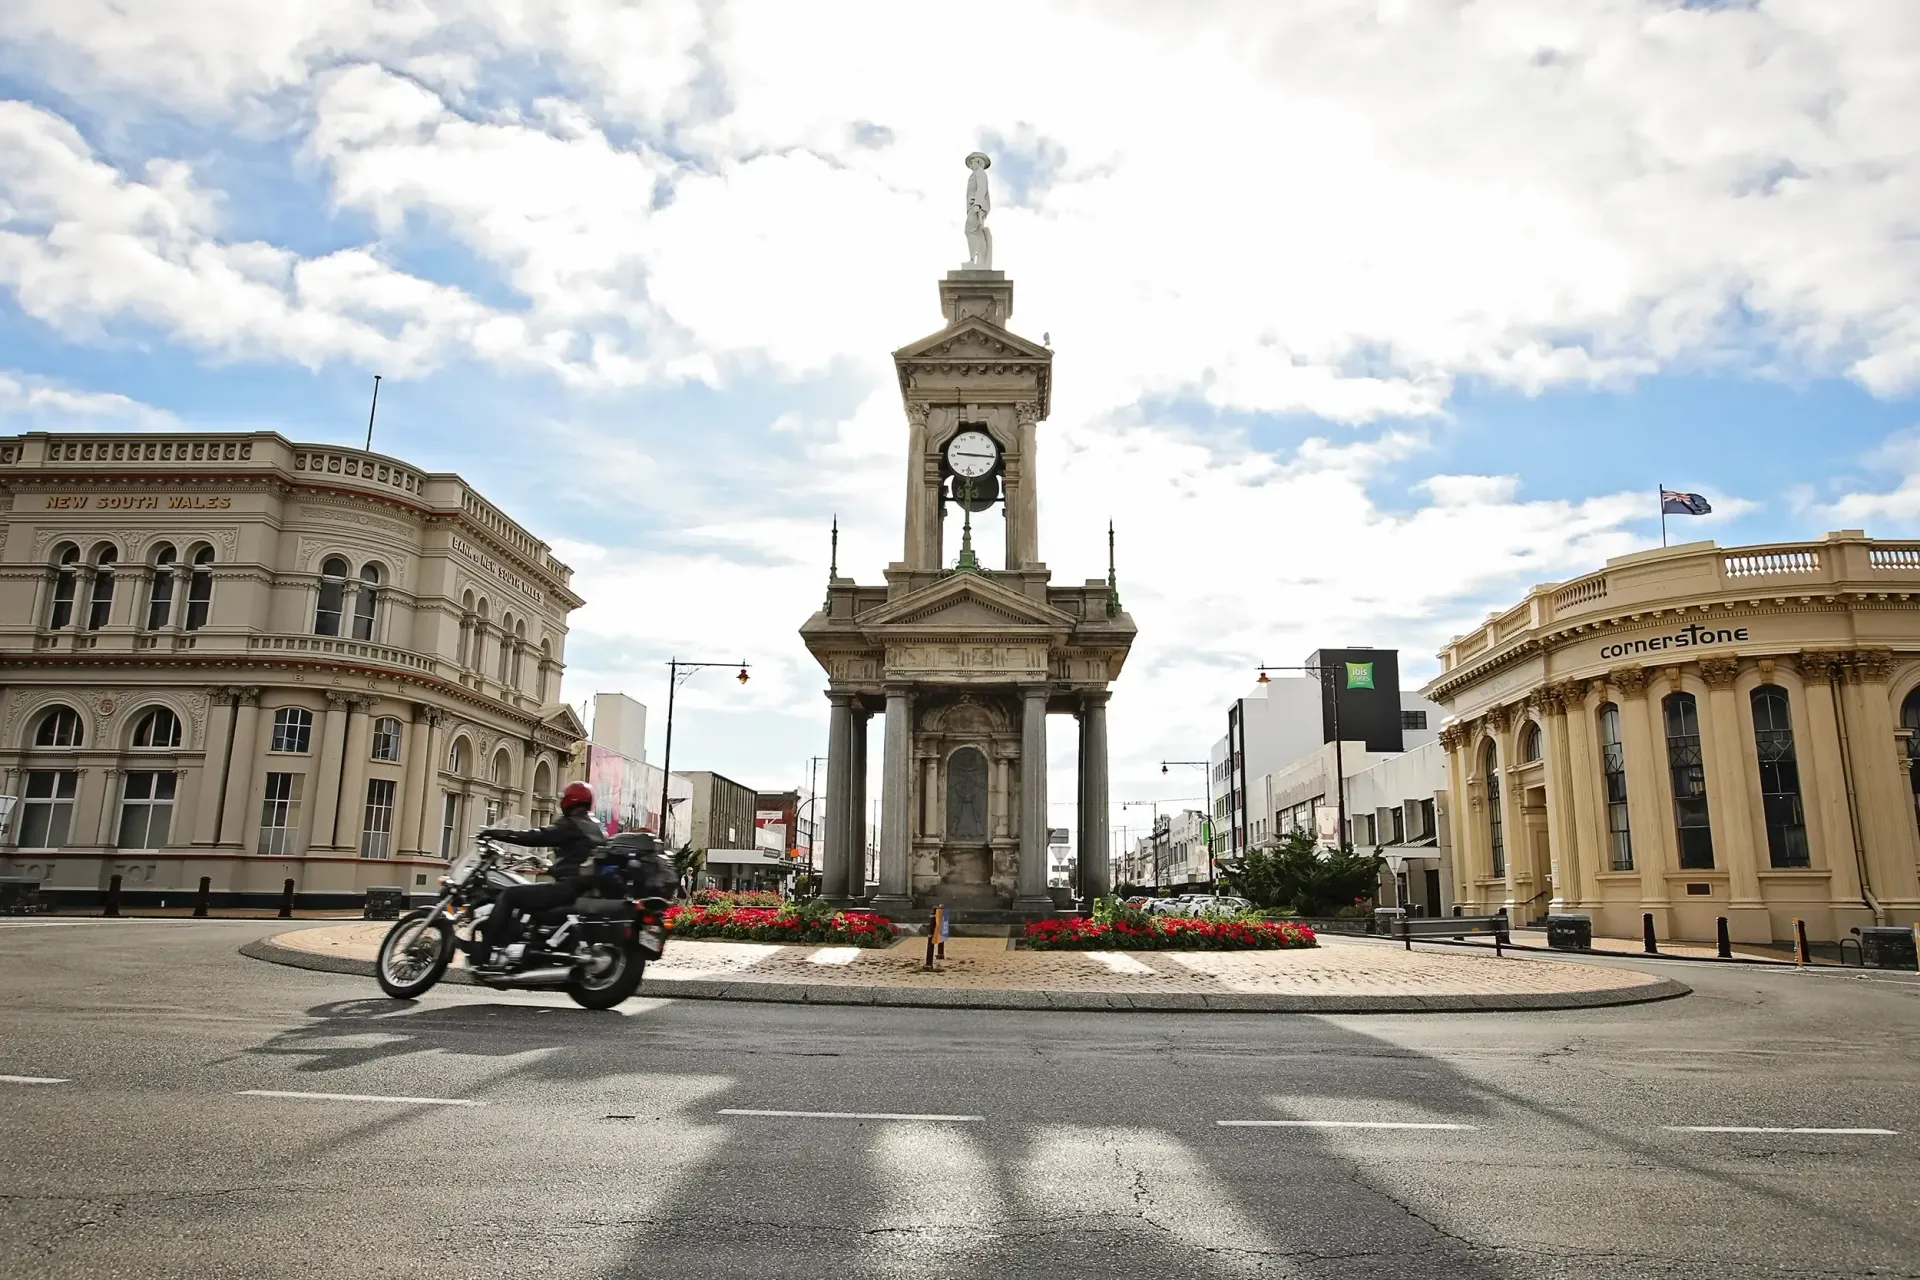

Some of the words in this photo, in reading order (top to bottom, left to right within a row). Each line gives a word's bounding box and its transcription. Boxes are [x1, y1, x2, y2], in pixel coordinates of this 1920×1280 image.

[46, 496, 89, 509] NEW
[96, 496, 158, 509] SOUTH
[168, 496, 231, 509] WALES
[452, 536, 473, 559] BANK
[480, 554, 497, 574] NEW
[498, 567, 520, 589] SOUTH
[521, 582, 542, 602] WALES
[1600, 624, 1749, 659] cornerstone
[1352, 667, 1368, 675] ibis
[293, 673, 405, 694] BANK
